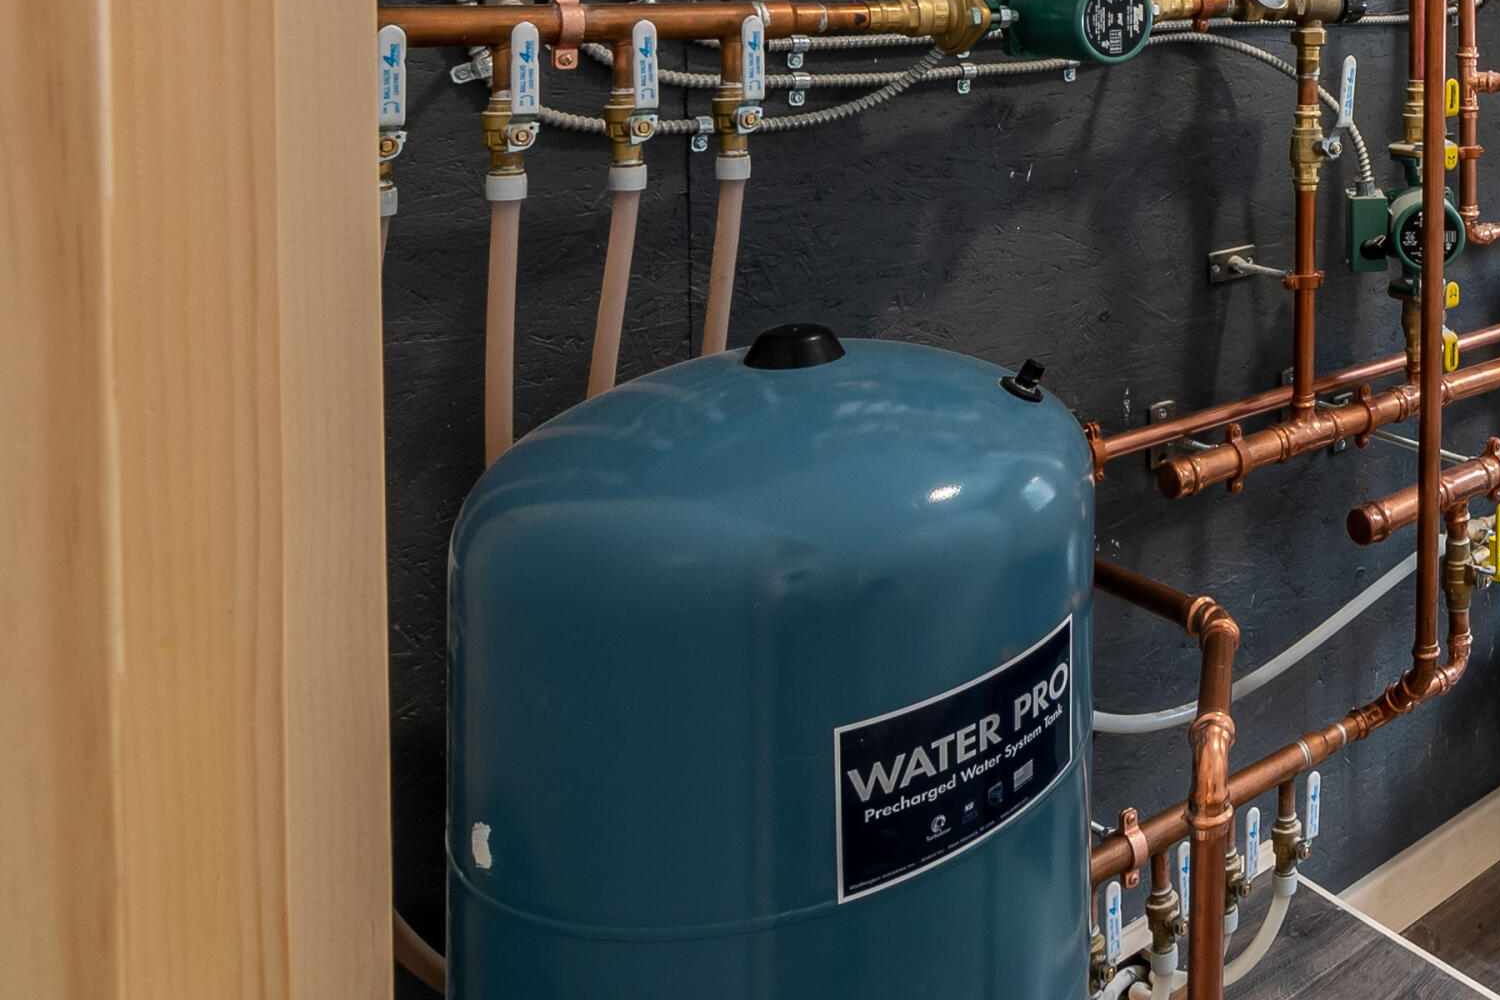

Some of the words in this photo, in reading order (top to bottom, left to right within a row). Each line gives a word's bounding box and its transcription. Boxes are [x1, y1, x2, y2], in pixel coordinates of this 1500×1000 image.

[847, 711, 1003, 803] WATER
[1013, 661, 1069, 733] PRO
[864, 773, 957, 823] Precharged
[960, 752, 1002, 787] Water
[1004, 726, 1042, 760] System
[1043, 703, 1063, 728] Tank
